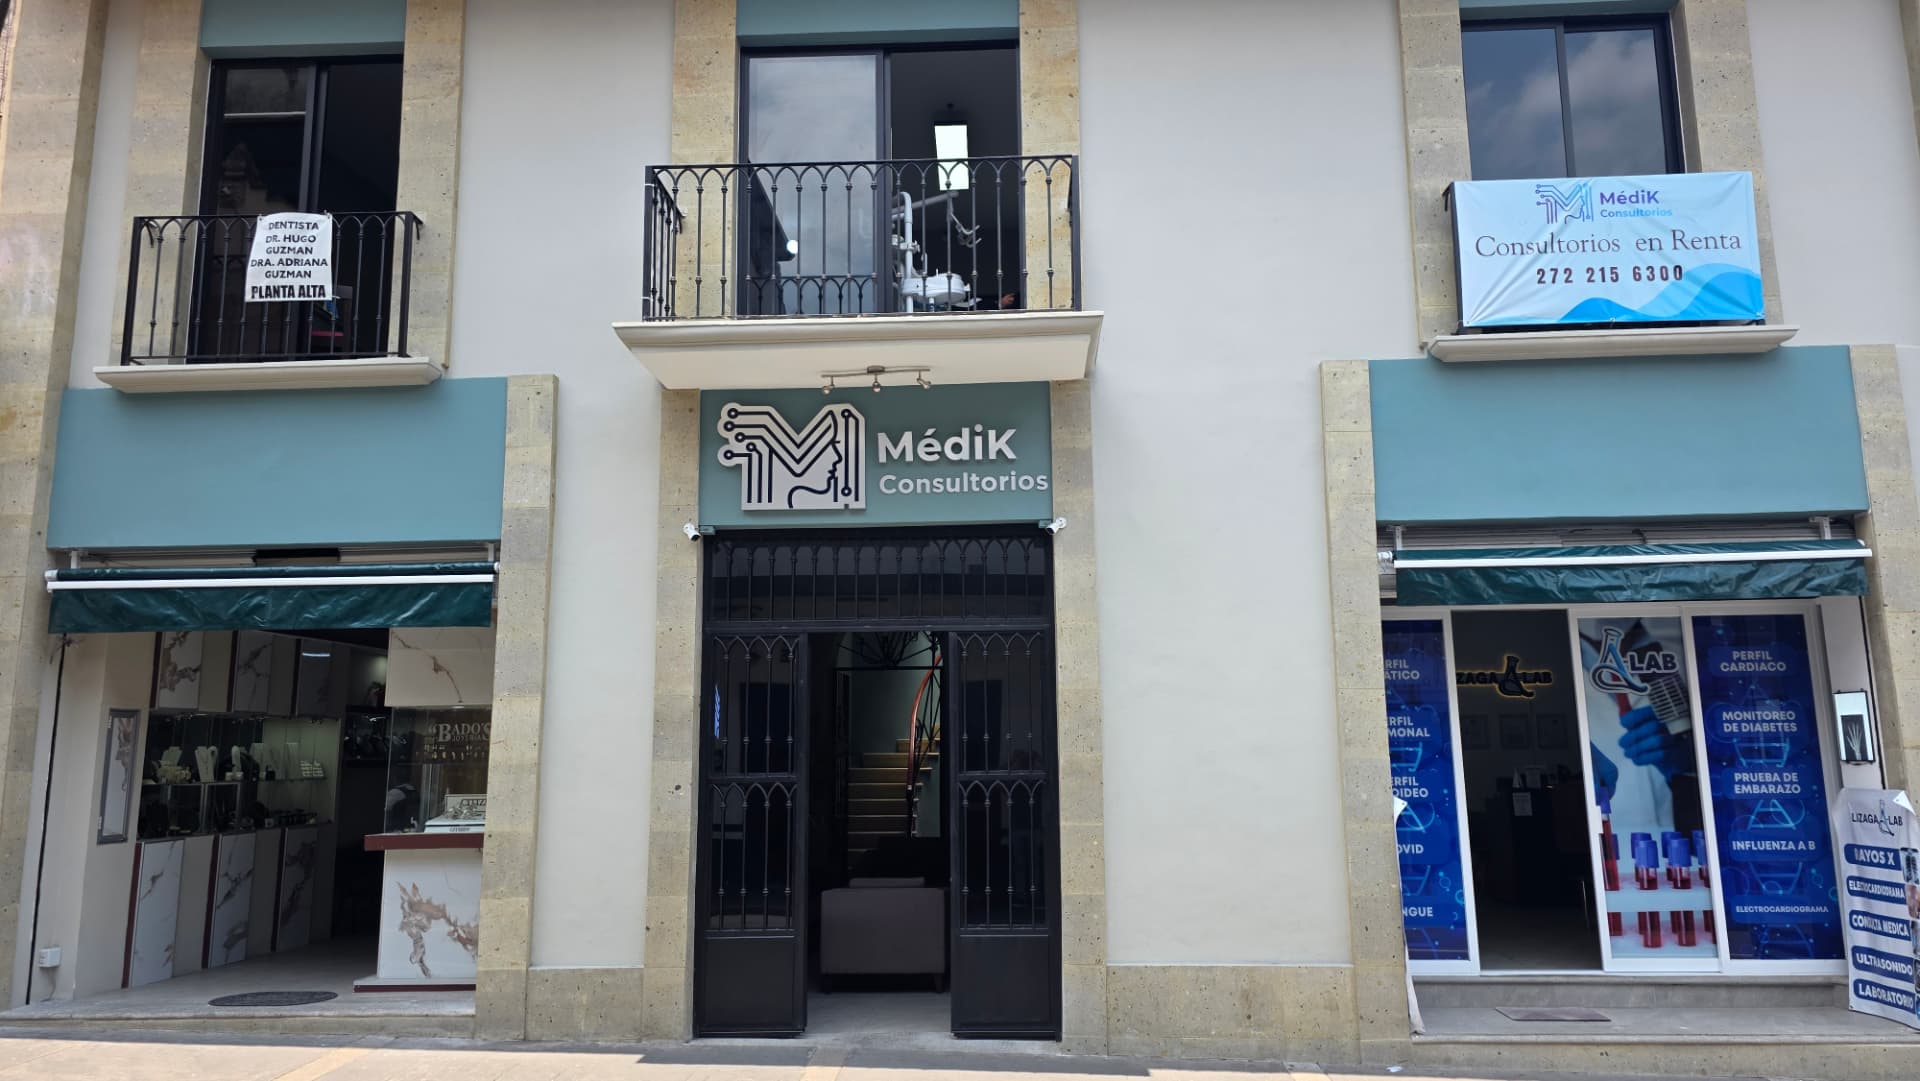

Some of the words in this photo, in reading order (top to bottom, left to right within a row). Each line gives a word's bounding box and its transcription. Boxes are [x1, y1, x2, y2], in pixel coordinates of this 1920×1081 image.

[1600, 190, 1659, 205] MédiK
[1600, 208, 1673, 218] Consultorios
[268, 221, 319, 230] DENTISTA
[265, 235, 280, 243] DR.
[283, 234, 317, 243] HUGO
[1475, 231, 1621, 257] Consultorios
[1635, 235, 1663, 252] en
[1670, 228, 1742, 251] Renta
[266, 246, 313, 255] GUZMAN
[250, 258, 275, 267] DRA.
[277, 258, 328, 267] ADRIANA
[265, 270, 312, 279] GUZMAN
[1536, 267, 1574, 285] 272
[1586, 266, 1620, 283] 215
[1632, 264, 1684, 282] 6300
[251, 285, 295, 299] PLANTA
[298, 284, 326, 298] ALTA
[877, 424, 1017, 463] MédiK
[879, 470, 1049, 495] Consultorios
[1732, 651, 1772, 661] PERFIL
[1385, 659, 1409, 669] RFIL
[1720, 662, 1787, 672] CARDIACO
[1456, 672, 1498, 684] ZAGA
[1388, 716, 1414, 726] RFIL
[1722, 711, 1796, 721] MONITOREO
[1388, 727, 1431, 737] MONAL
[1723, 723, 1739, 733] DE
[1741, 722, 1798, 732] DIABETES
[1734, 772, 1781, 782] PRUEBA
[1783, 772, 1799, 782] DE
[1392, 787, 1429, 798] OIDEO
[1734, 784, 1801, 794] EMBARAZO
[1851, 812, 1879, 824] LIZAGA
[1888, 815, 1903, 826] LAB
[1396, 844, 1424, 854] OVID
[1732, 841, 1796, 850] INFLUENZA
[1797, 841, 1806, 850] A
[1808, 841, 1816, 850] B
[1887, 851, 1895, 866] X
[1402, 907, 1433, 917] NGUE
[1735, 905, 1829, 913] ELECTROCARDIOGRAMA
